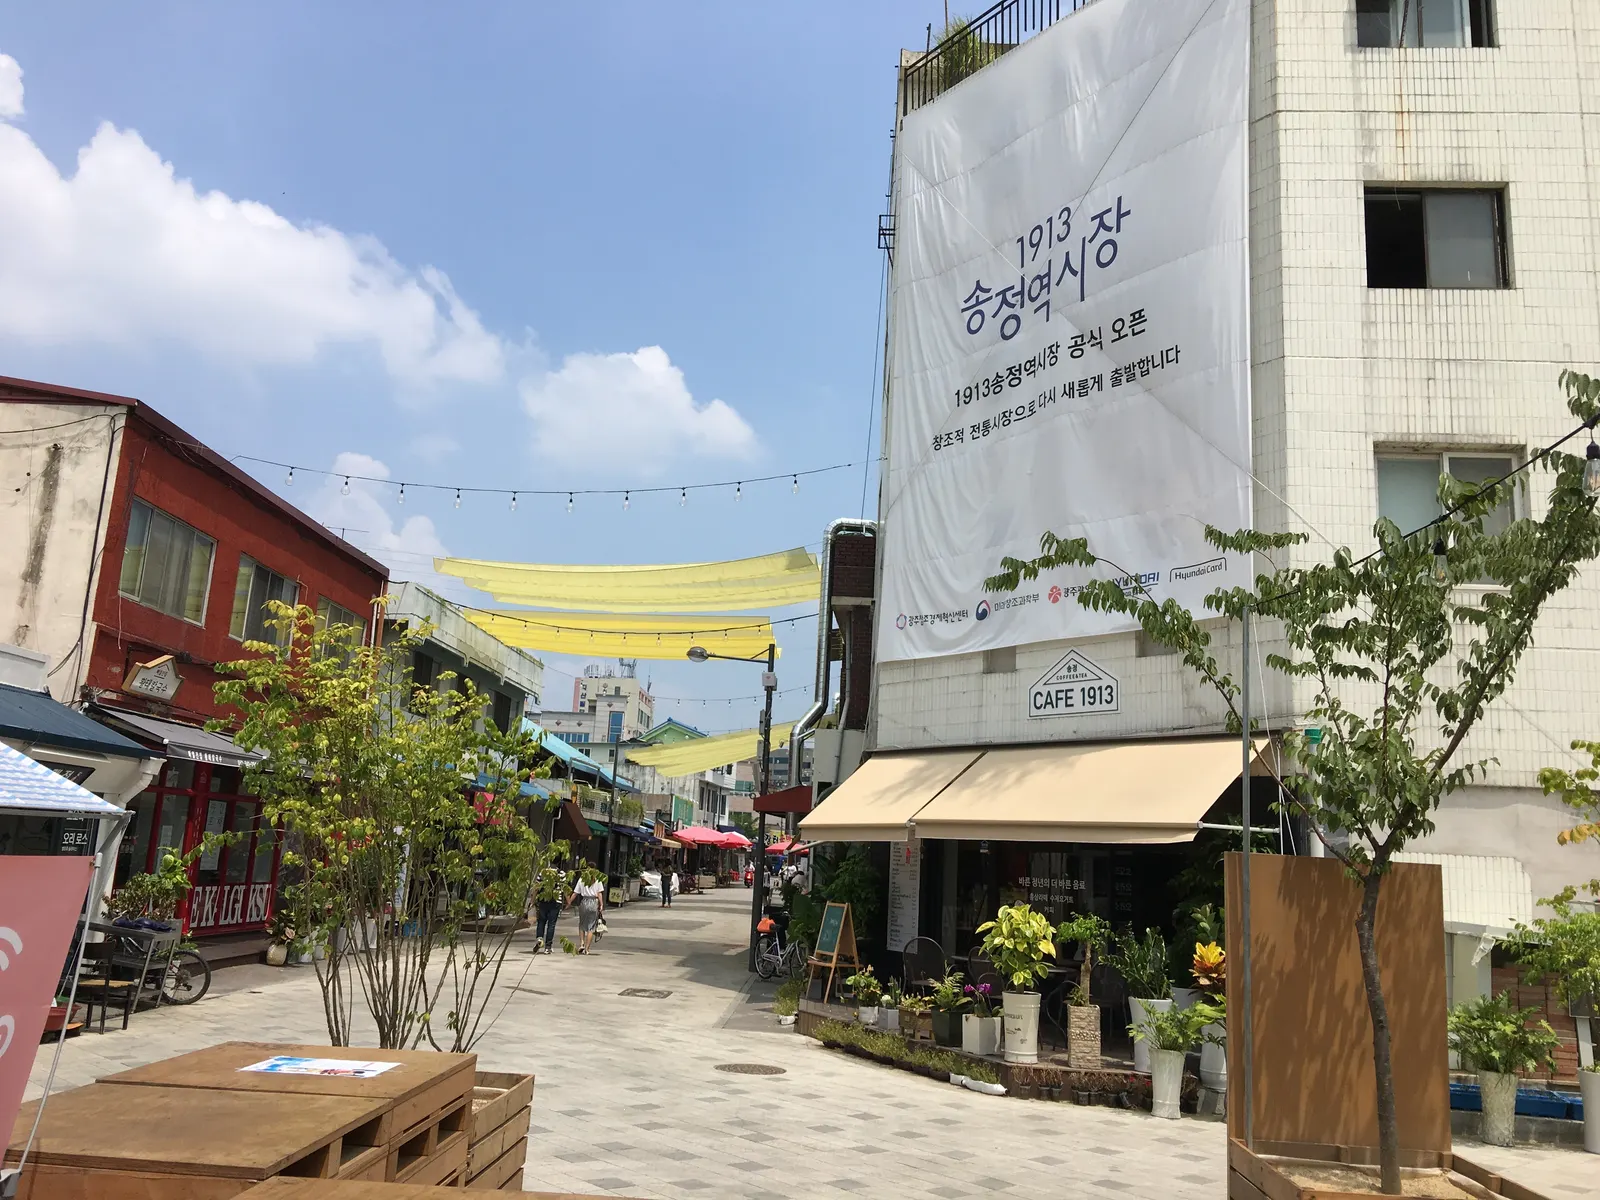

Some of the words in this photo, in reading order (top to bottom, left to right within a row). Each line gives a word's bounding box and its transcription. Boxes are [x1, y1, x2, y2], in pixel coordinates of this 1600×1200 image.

[961, 195, 1131, 341] 송정역시장
[1016, 206, 1072, 268] 1913
[955, 341, 1060, 407] 1913송정역시장
[1067, 326, 1103, 359] 공식
[1111, 308, 1148, 343] 오픈
[932, 428, 965, 451] 창조적
[970, 400, 1037, 441] 전통시장으로
[1038, 386, 1056, 409] 다시
[1061, 373, 1103, 399] 새롭게
[1109, 344, 1181, 388] 출발합니다
[908, 609, 969, 627] 광주창조경제혁신센터
[994, 593, 1040, 612] 미래창조과학부
[1033, 688, 1075, 710] CAFE
[1080, 684, 1114, 708] 1913
